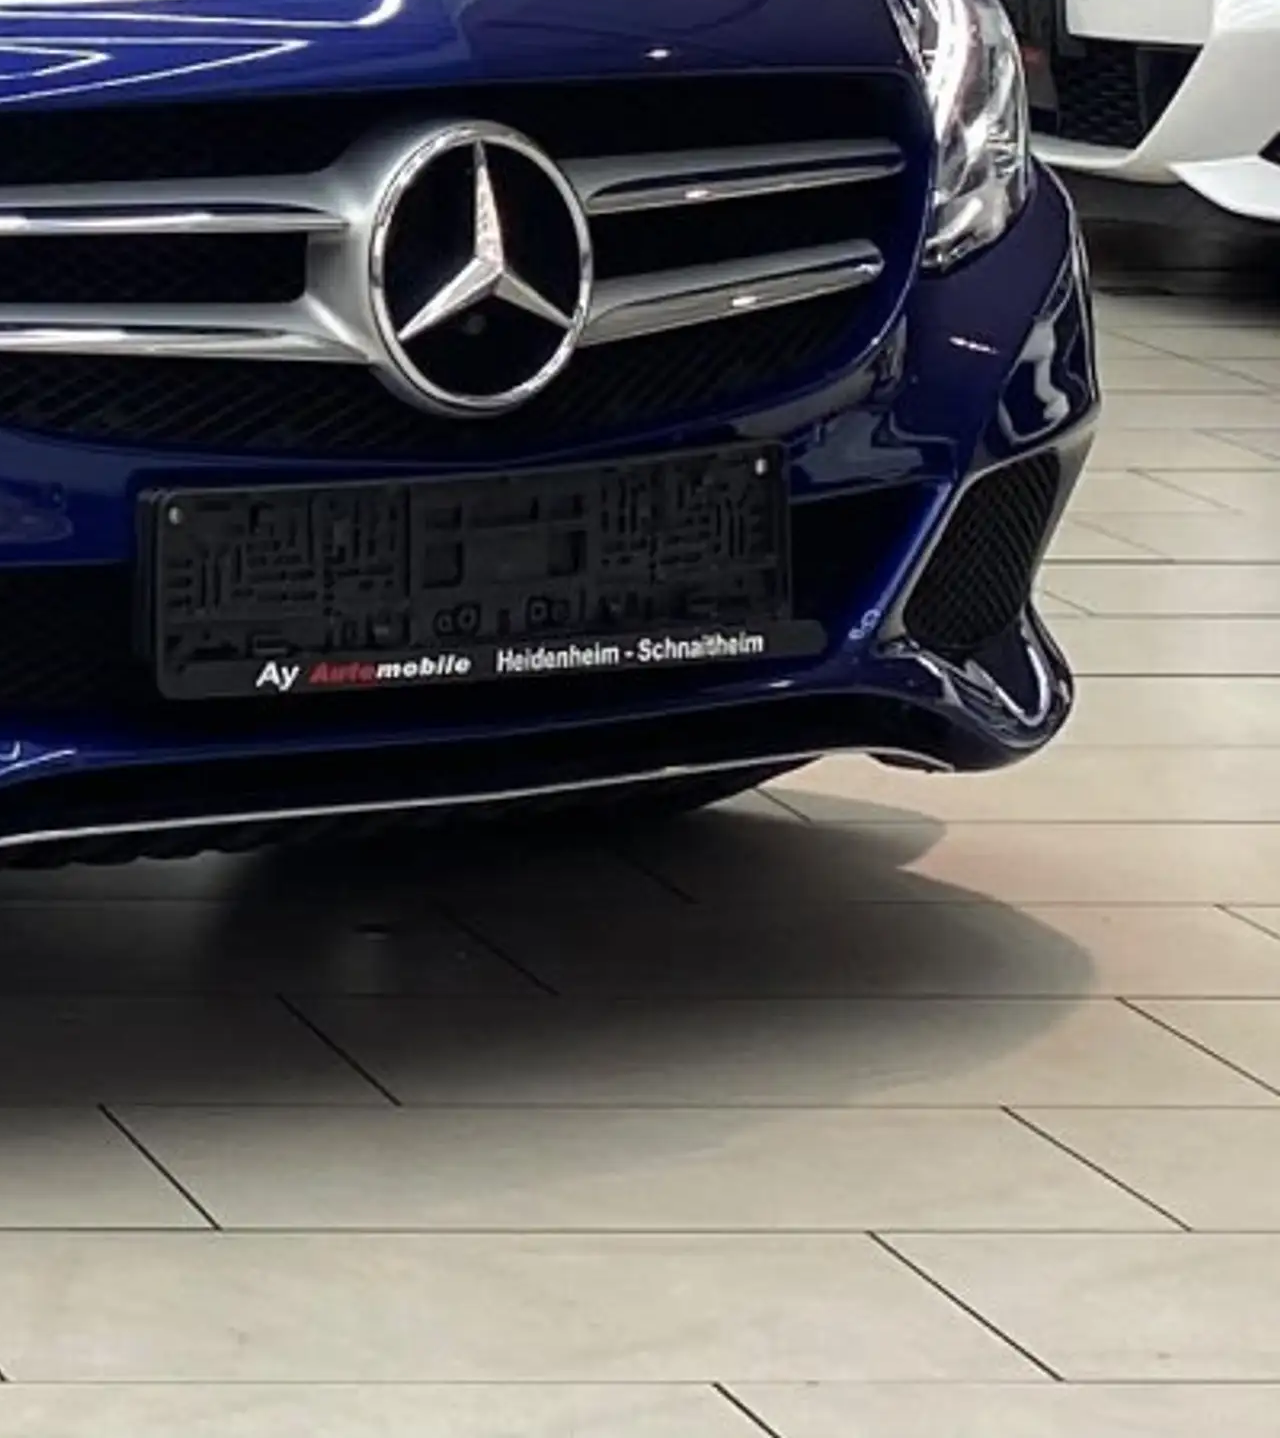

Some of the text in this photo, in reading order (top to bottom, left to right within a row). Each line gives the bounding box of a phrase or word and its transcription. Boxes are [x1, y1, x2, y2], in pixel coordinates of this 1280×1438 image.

[255, 660, 300, 693] Ay
[308, 653, 472, 684] Automobile
[495, 642, 620, 673] Heidenheim
[637, 631, 765, 662] Schnaitheim
